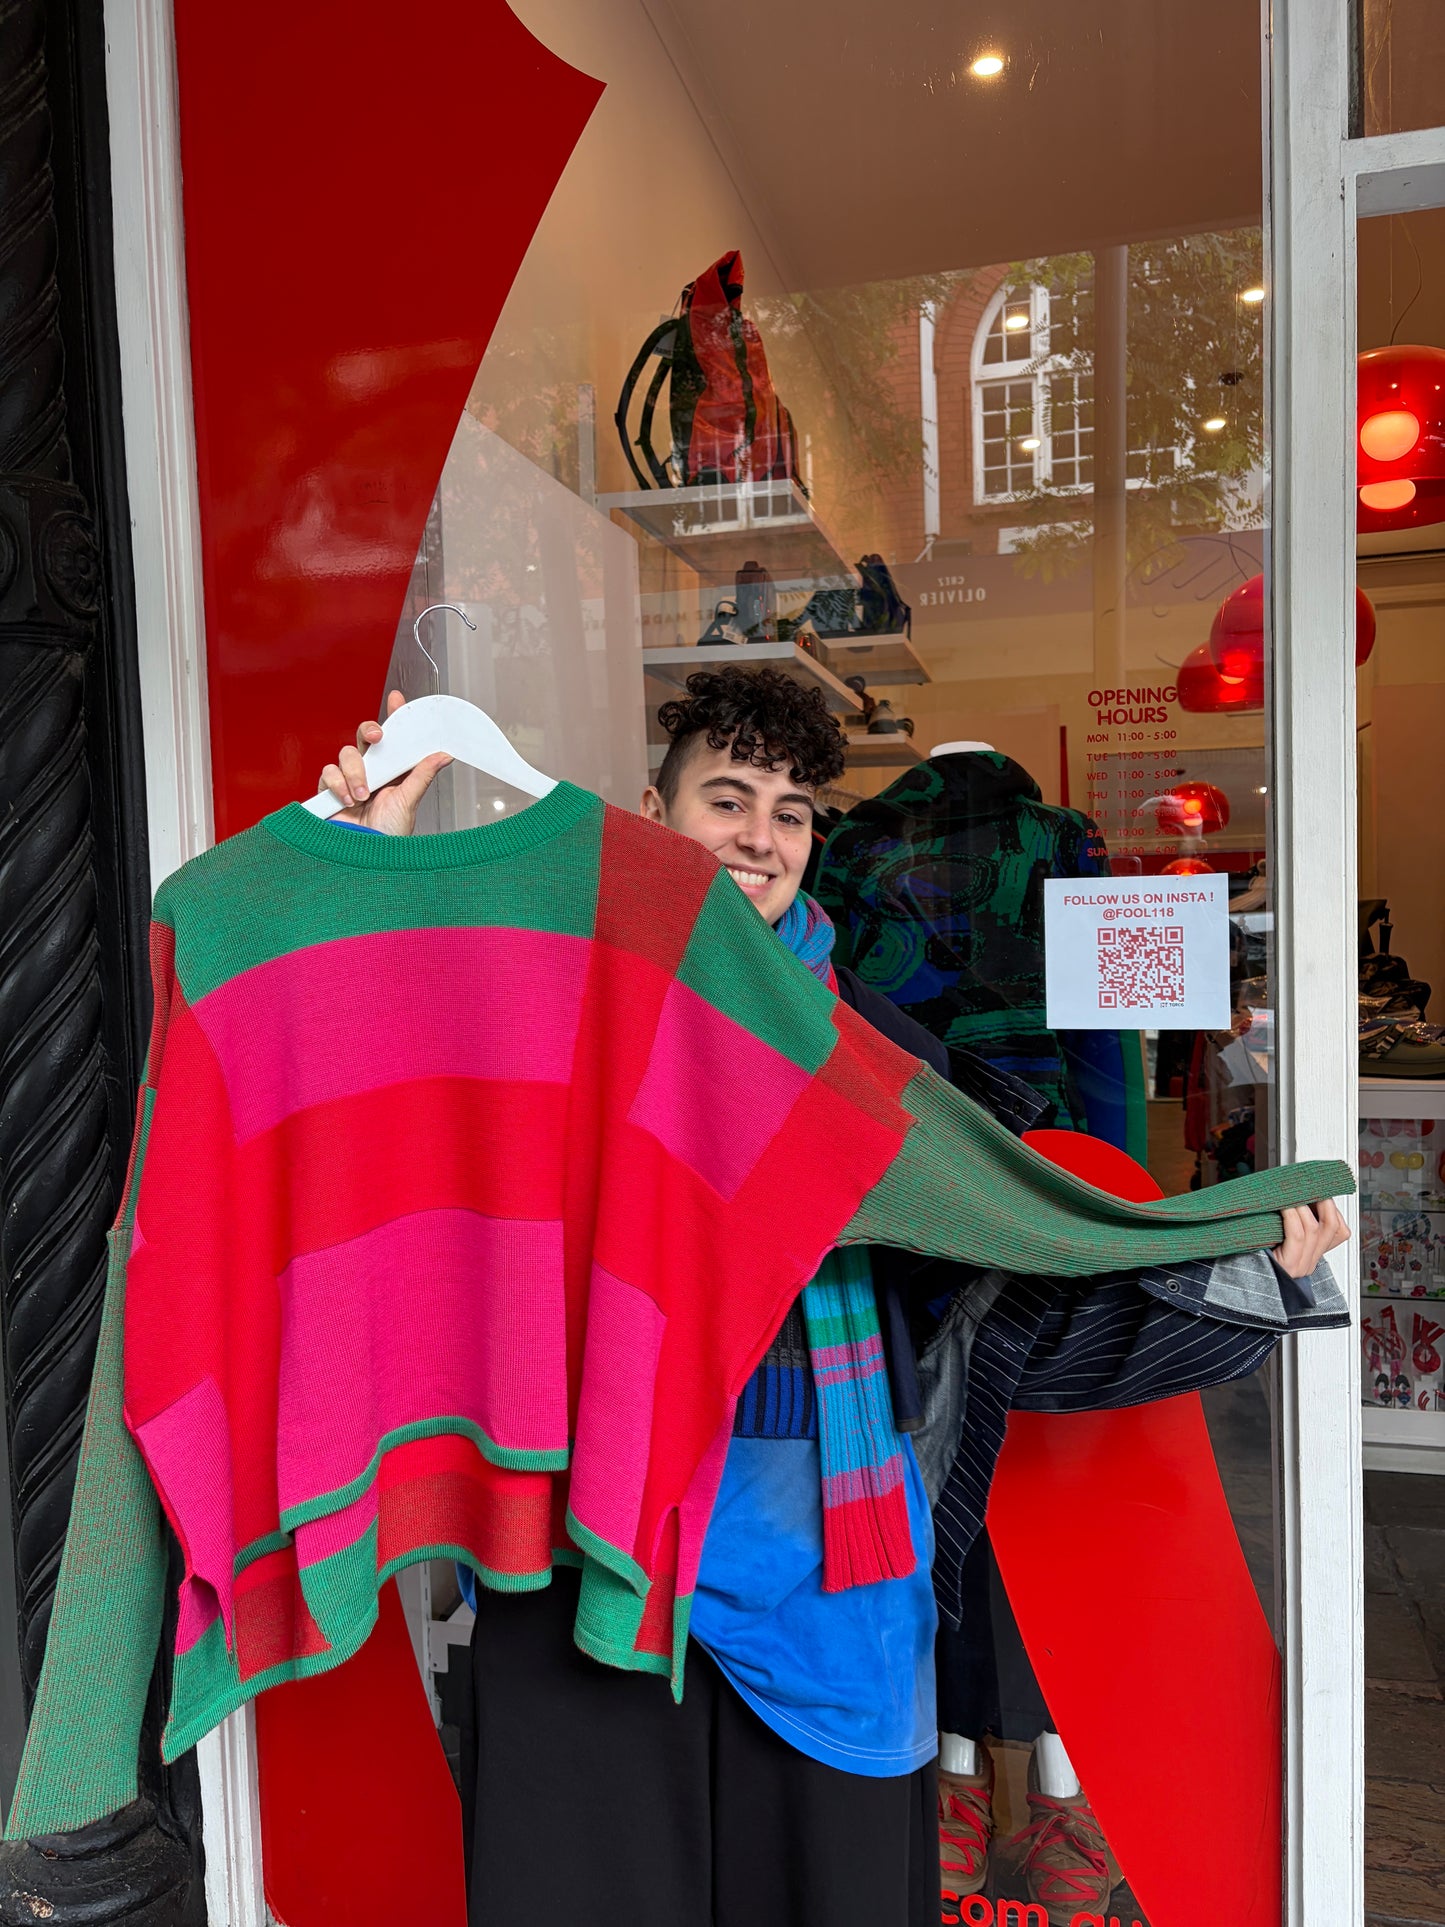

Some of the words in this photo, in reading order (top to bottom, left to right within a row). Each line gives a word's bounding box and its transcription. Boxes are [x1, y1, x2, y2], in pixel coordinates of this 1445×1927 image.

[1087, 686, 1178, 707] OPENING
[1097, 706, 1168, 726] HOURS
[1086, 733, 1109, 743] MON
[1117, 731, 1144, 741] 11:00
[1153, 730, 1177, 740] 5:00
[1086, 753, 1109, 761] TUE
[1117, 751, 1144, 760] 11:00
[1153, 749, 1177, 760] 5:00
[1086, 772, 1109, 780] WED
[1117, 770, 1144, 780] 11:00
[1154, 768, 1177, 779] 5:00
[1086, 791, 1108, 800] THU
[1117, 789, 1144, 799] 11:00
[1154, 788, 1177, 798] 5:00
[1087, 810, 1108, 819] FRI
[1086, 828, 1109, 838] SAT
[1086, 847, 1109, 857] SUN
[1063, 895, 1119, 906] FOLLOW
[1122, 894, 1140, 905] US
[1143, 893, 1163, 904] ON
[1166, 892, 1207, 903] INSTA
[1102, 907, 1174, 921] @FOOL118
